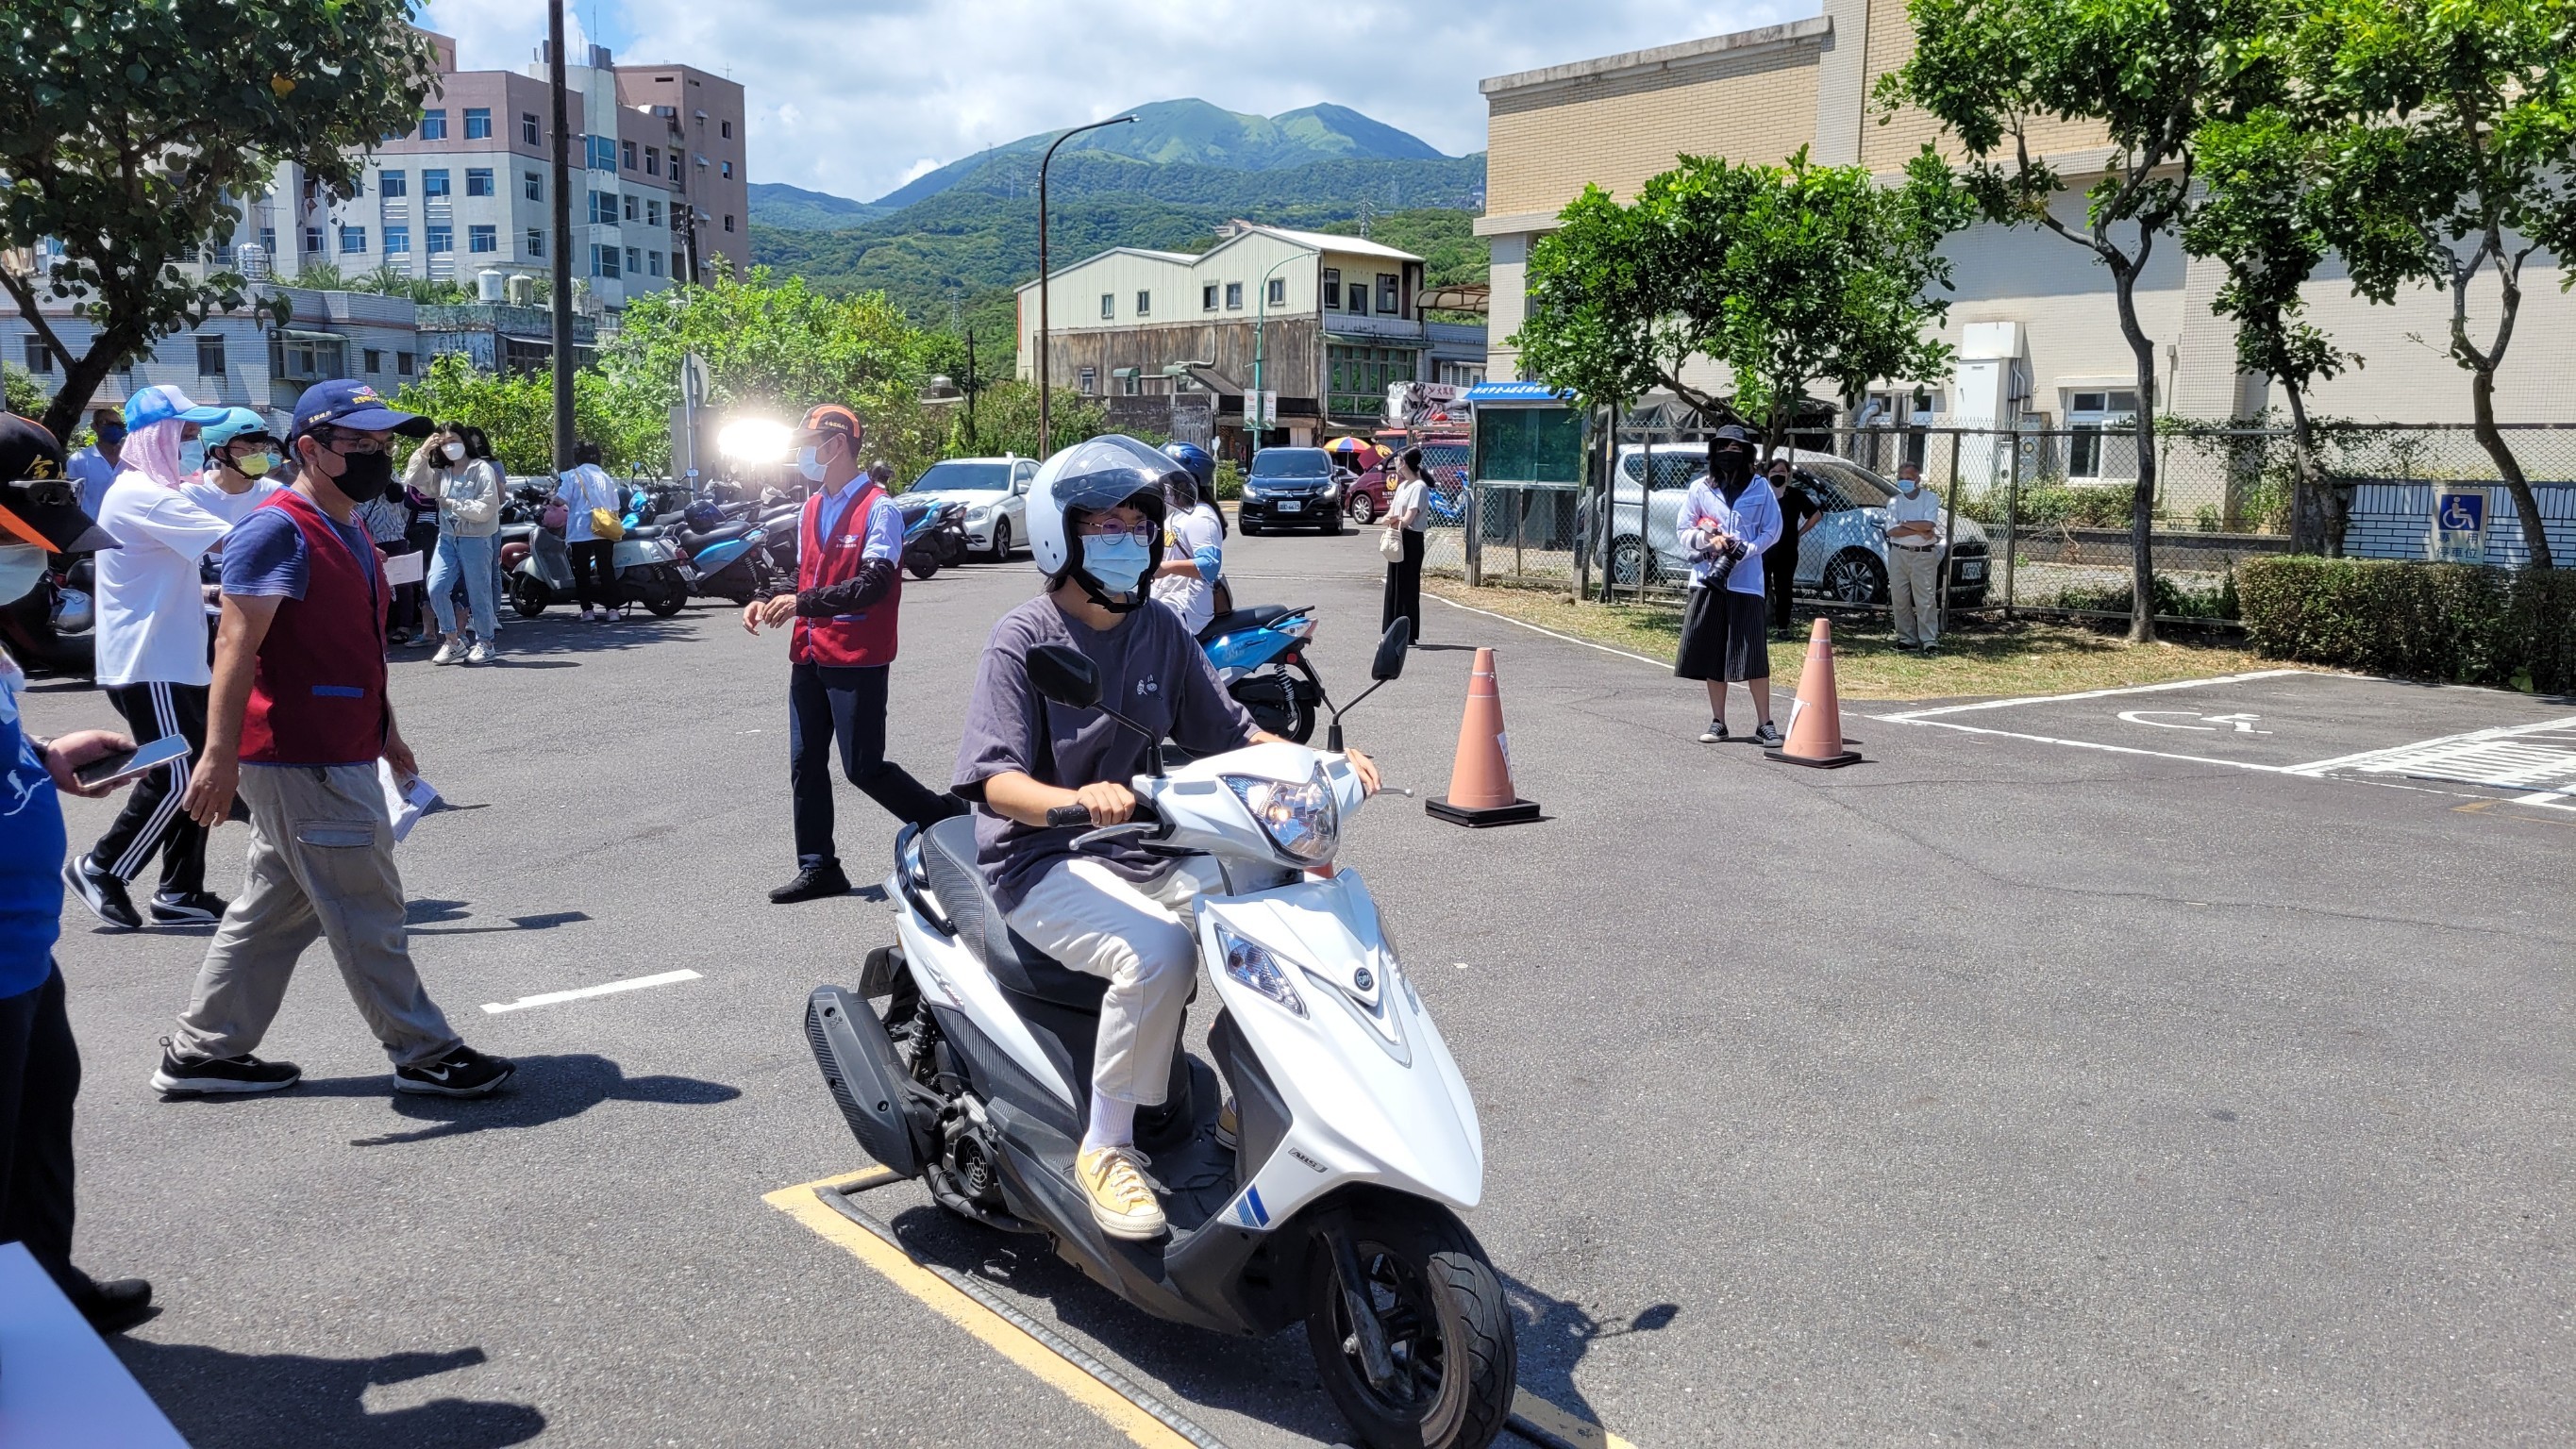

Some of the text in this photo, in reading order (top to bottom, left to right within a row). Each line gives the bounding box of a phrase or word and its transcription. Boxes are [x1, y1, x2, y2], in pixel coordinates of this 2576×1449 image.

[2438, 532, 2479, 544] 專用
[2436, 546, 2478, 559] 停車位
